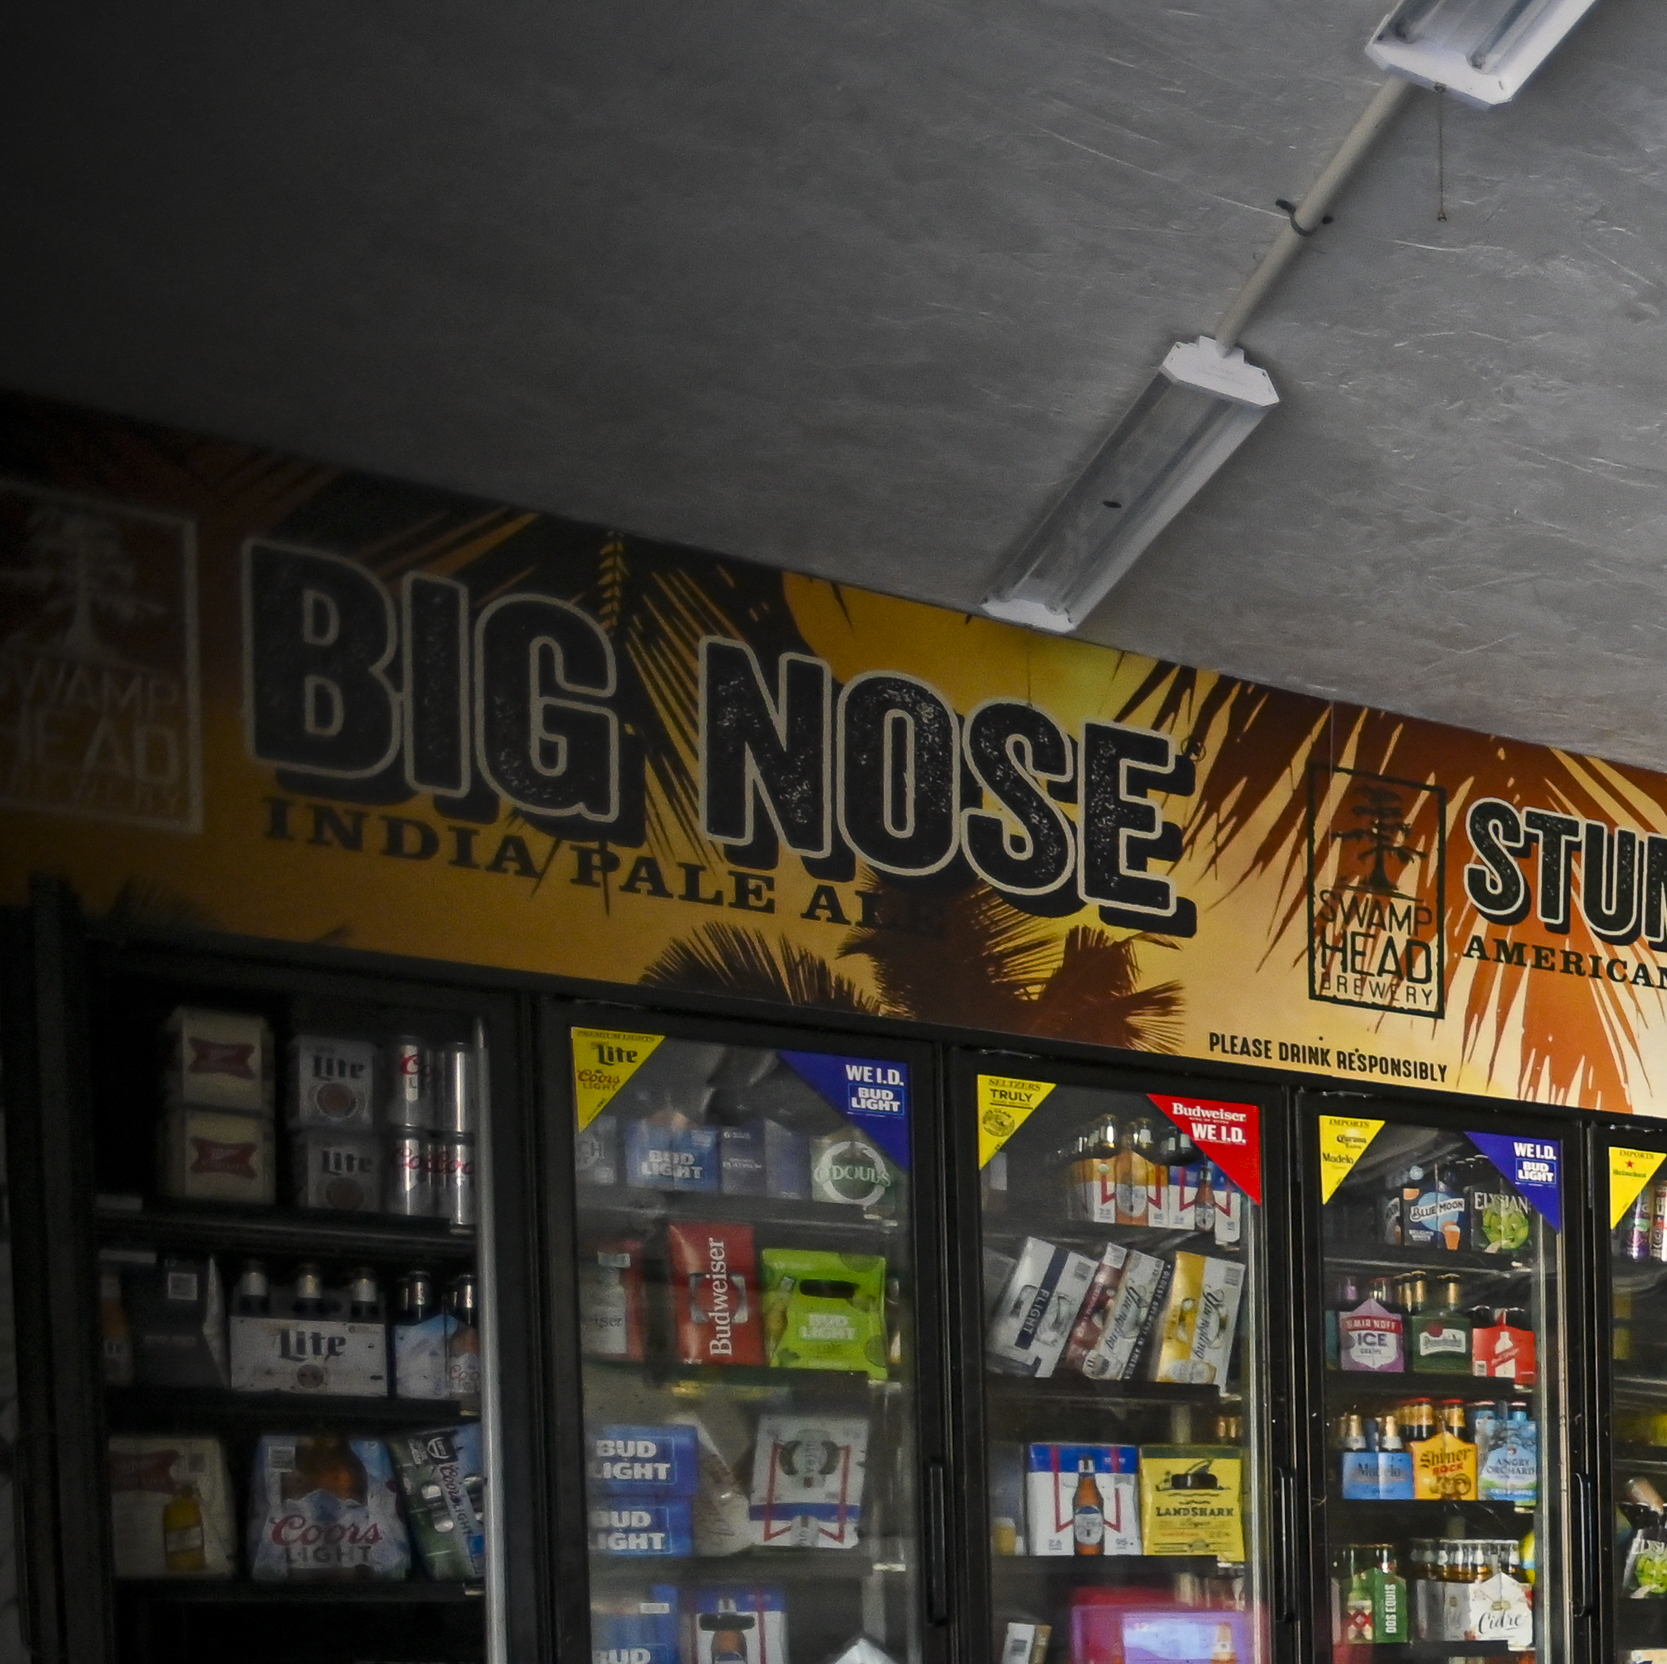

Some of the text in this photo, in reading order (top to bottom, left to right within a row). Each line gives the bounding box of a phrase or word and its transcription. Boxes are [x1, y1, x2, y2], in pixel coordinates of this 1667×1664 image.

[241, 535, 1190, 930] BIG NOSE
[262, 797, 543, 878] INDIA
[570, 843, 776, 912] PALE
[1319, 889, 1433, 938] SWAMP
[1319, 932, 1432, 985] HEAD
[1320, 972, 1433, 1006] BREWERY
[596, 1043, 638, 1066] Lite
[1209, 1032, 1448, 1083] PLEASE DRINK RESPONSIBLY
[845, 1065, 904, 1086] WE I.D.
[858, 1087, 894, 1101] BUD
[990, 1088, 1033, 1103] TRULY
[851, 1097, 901, 1113] LIGHT
[1172, 1102, 1247, 1122] Budweiser
[1191, 1121, 1247, 1144] WE I.D.
[1329, 1118, 1370, 1128] IMPORTS
[649, 1150, 696, 1165] BUD
[1322, 1152, 1355, 1165] Modelo
[1514, 1142, 1557, 1160] WE I.D.
[641, 1162, 704, 1179] LIGHT
[1517, 1168, 1555, 1182] LIGHT
[1523, 1160, 1549, 1172] BUD
[1409, 1199, 1465, 1222] BLUE MOON
[1474, 1191, 1529, 1213] ELYSIAN
[709, 1237, 732, 1356] Budweiser
[1023, 1288, 1050, 1334] FLIGHT
[800, 1324, 856, 1341] LIGHT
[1346, 1316, 1397, 1330] SMIRNOFF
[277, 1329, 347, 1362] Lite
[1357, 1331, 1388, 1347] ICE
[597, 1440, 657, 1458] BUD
[1420, 1447, 1472, 1471] Shiner
[1432, 1462, 1464, 1475] BOCK
[1485, 1465, 1536, 1476] ORCHARD
[1495, 1457, 1532, 1467] ANGRY
[1156, 1507, 1234, 1517] LANDSHARK
[270, 1514, 383, 1546] Coors
[1384, 1583, 1397, 1634] DOS EQUIS
[1478, 1611, 1523, 1634] Cidre
